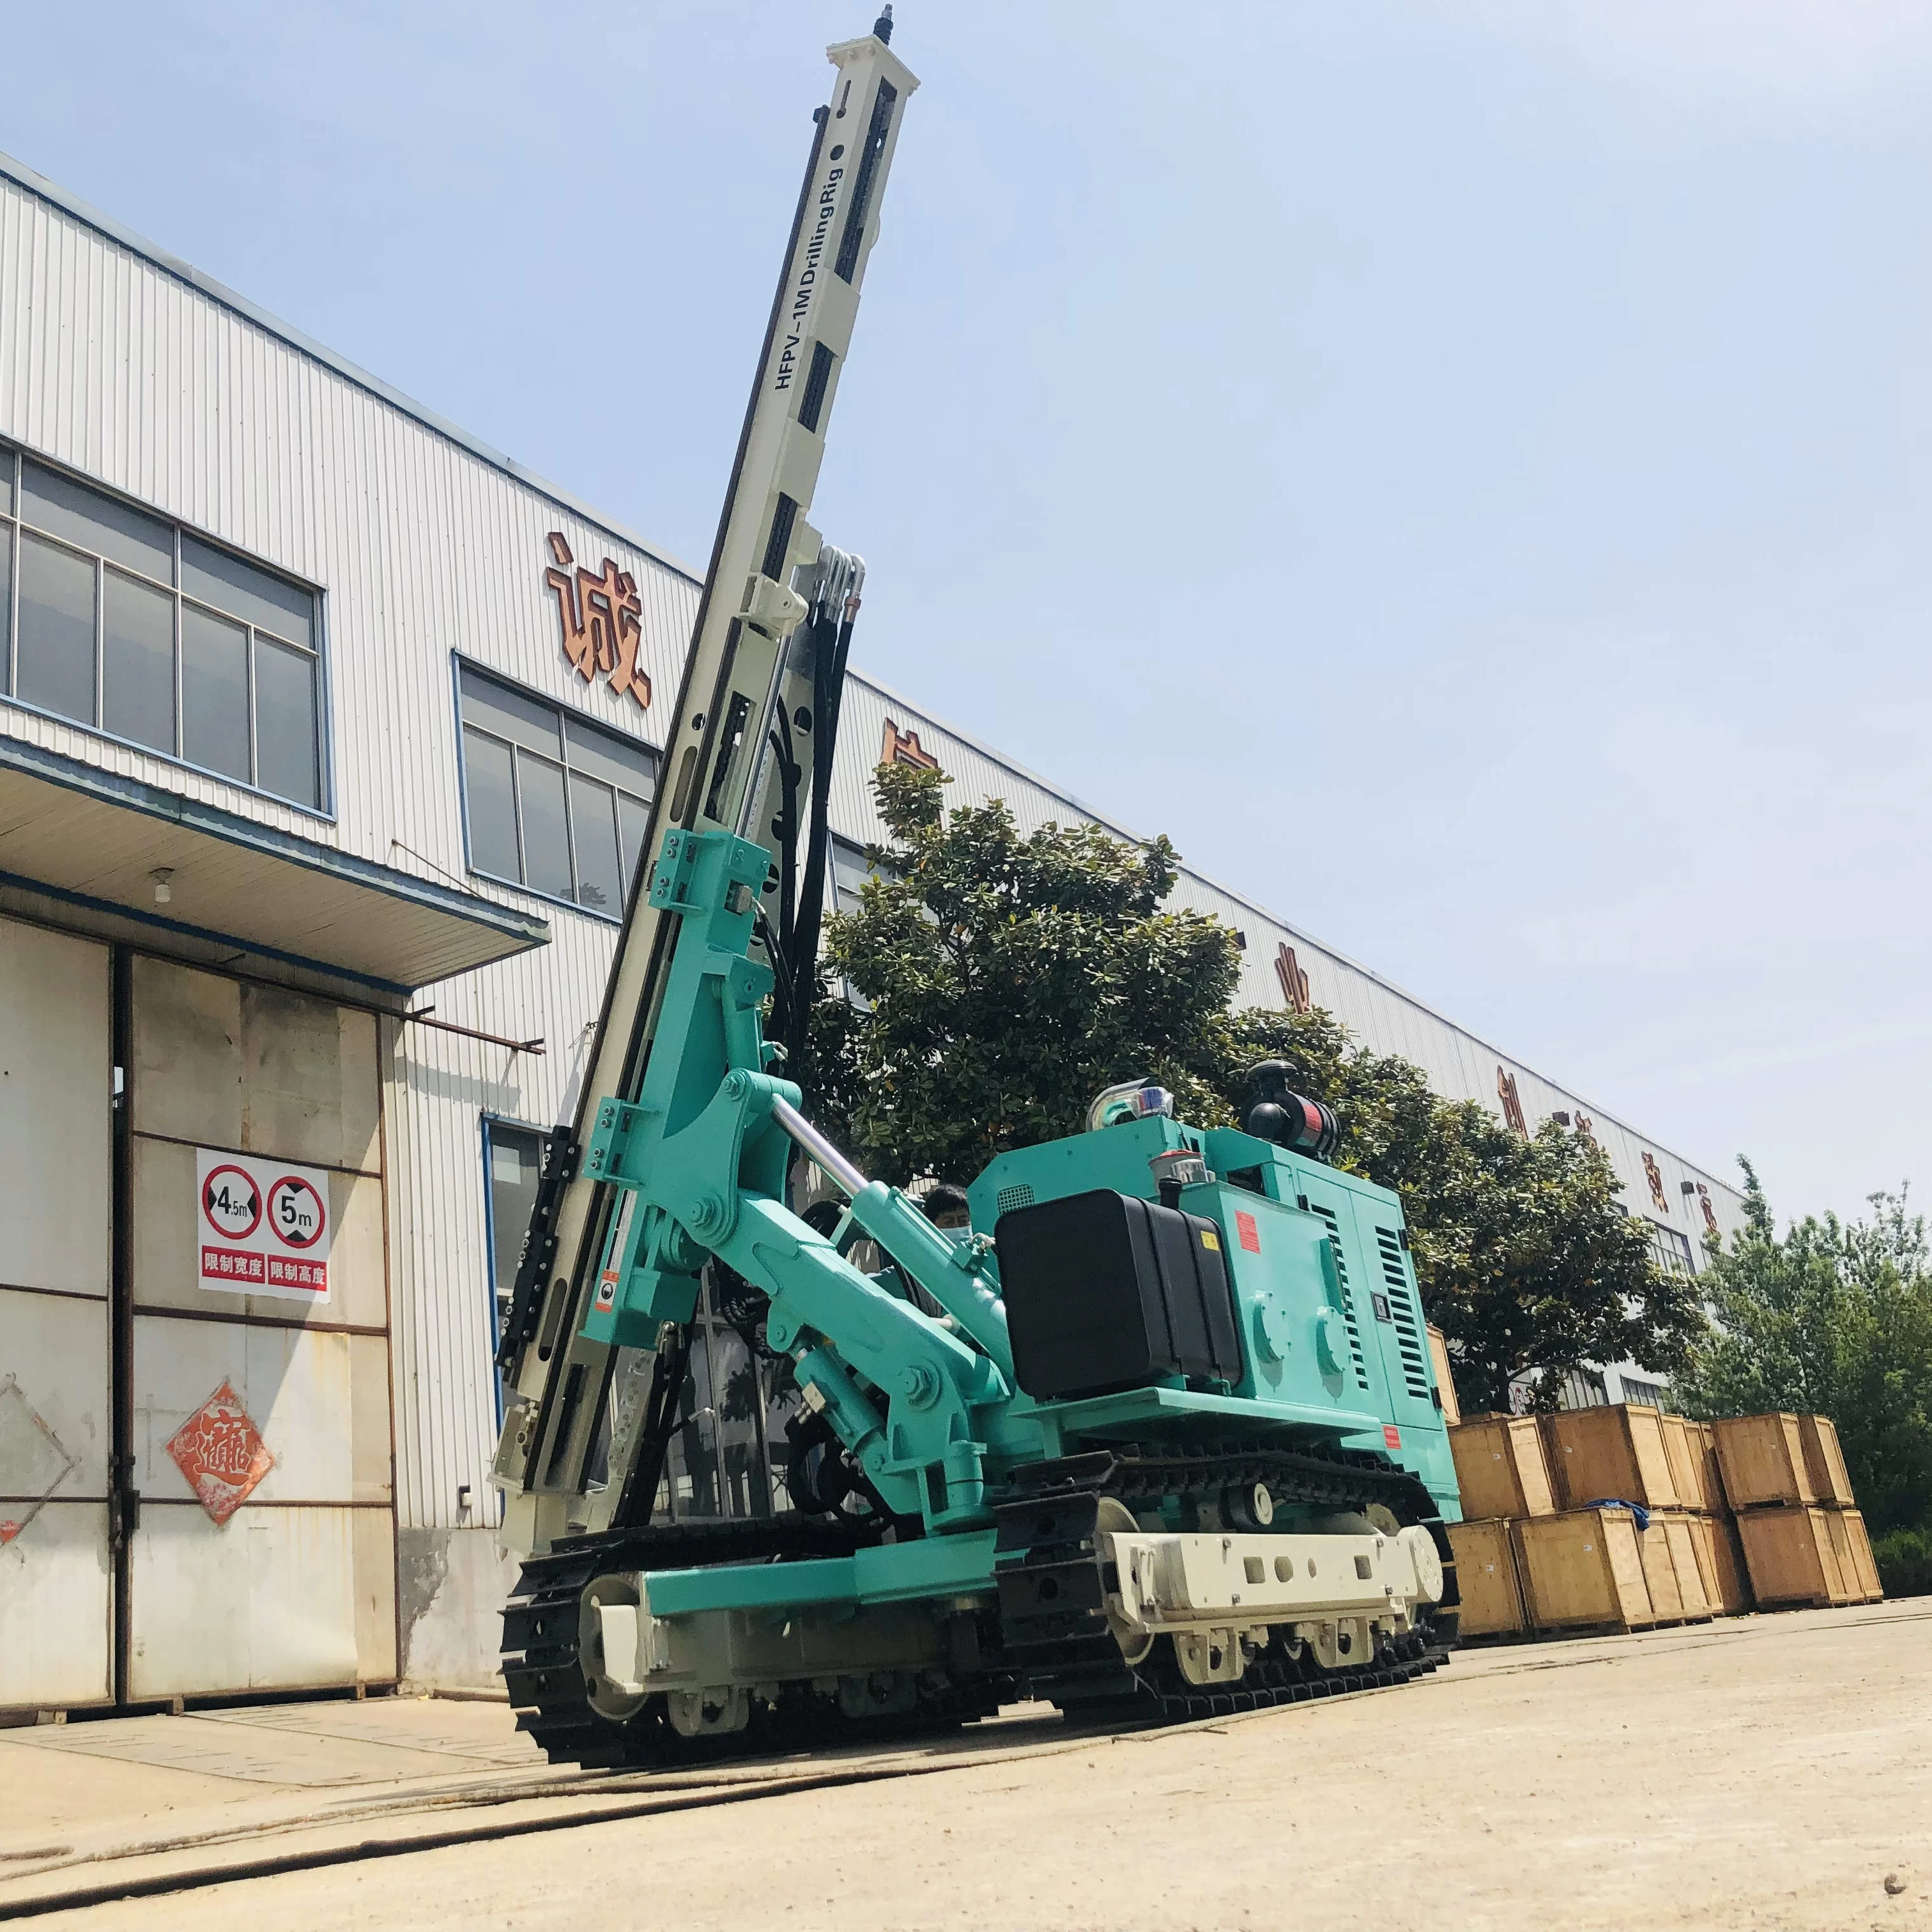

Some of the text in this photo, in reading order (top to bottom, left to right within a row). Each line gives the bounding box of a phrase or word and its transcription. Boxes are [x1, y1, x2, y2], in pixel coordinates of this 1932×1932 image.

[217, 1186, 248, 1217] 4.5m
[204, 1252, 263, 1277] 限制宽度
[270, 1261, 326, 1285] 限制高度
